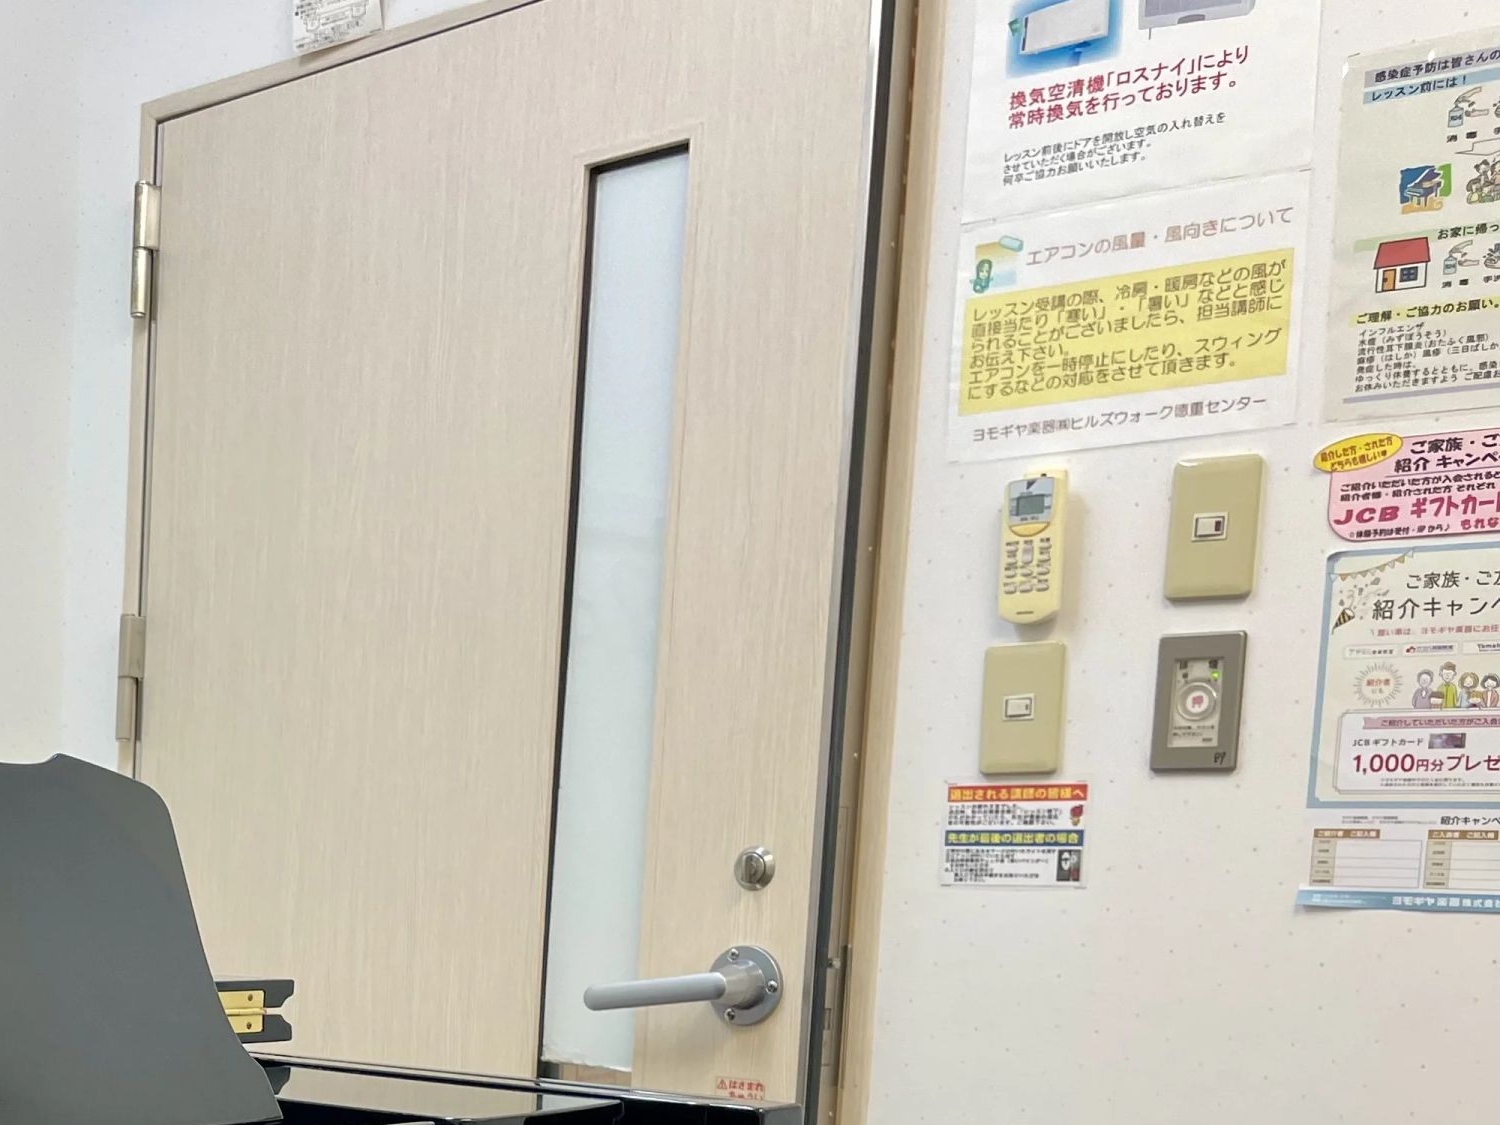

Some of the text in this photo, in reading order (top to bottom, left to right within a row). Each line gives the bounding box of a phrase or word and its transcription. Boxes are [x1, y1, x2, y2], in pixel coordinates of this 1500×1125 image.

[1009, 45, 1250, 110] 換気空清機「ロスナイ」により
[1372, 75, 1467, 102] レッスン前には！
[1375, 49, 1500, 83] 感染症予防は皆さんの
[1008, 71, 1237, 129] 常時換気を行っております。
[1003, 139, 1152, 174] させていただく場合がございます。
[1004, 112, 1226, 162] レッスン前後にドアを開放し空気の入れ替えを
[1002, 151, 1147, 186] 何卒ご協力お願いいたします。
[1026, 206, 1294, 266] エアコンの風量・風向きについて
[972, 278, 1285, 338] 直接当たり「寒い」・「暑い」などと感じ
[973, 258, 1287, 322] レッスン受講の際、冷房・暖房などの風が
[971, 296, 1283, 353] られることがございましたら、担当講師に
[1359, 322, 1425, 337] インフルエンザ
[968, 353, 1236, 400] にするなどの対応をさせて頂きます。
[970, 328, 1283, 385] エアコンを一時停止にしたり、スウィング
[970, 344, 1069, 369] お伝え下さい。
[1333, 491, 1500, 525] JCB ギフトカー
[729, 1080, 765, 1092] はさまれ
